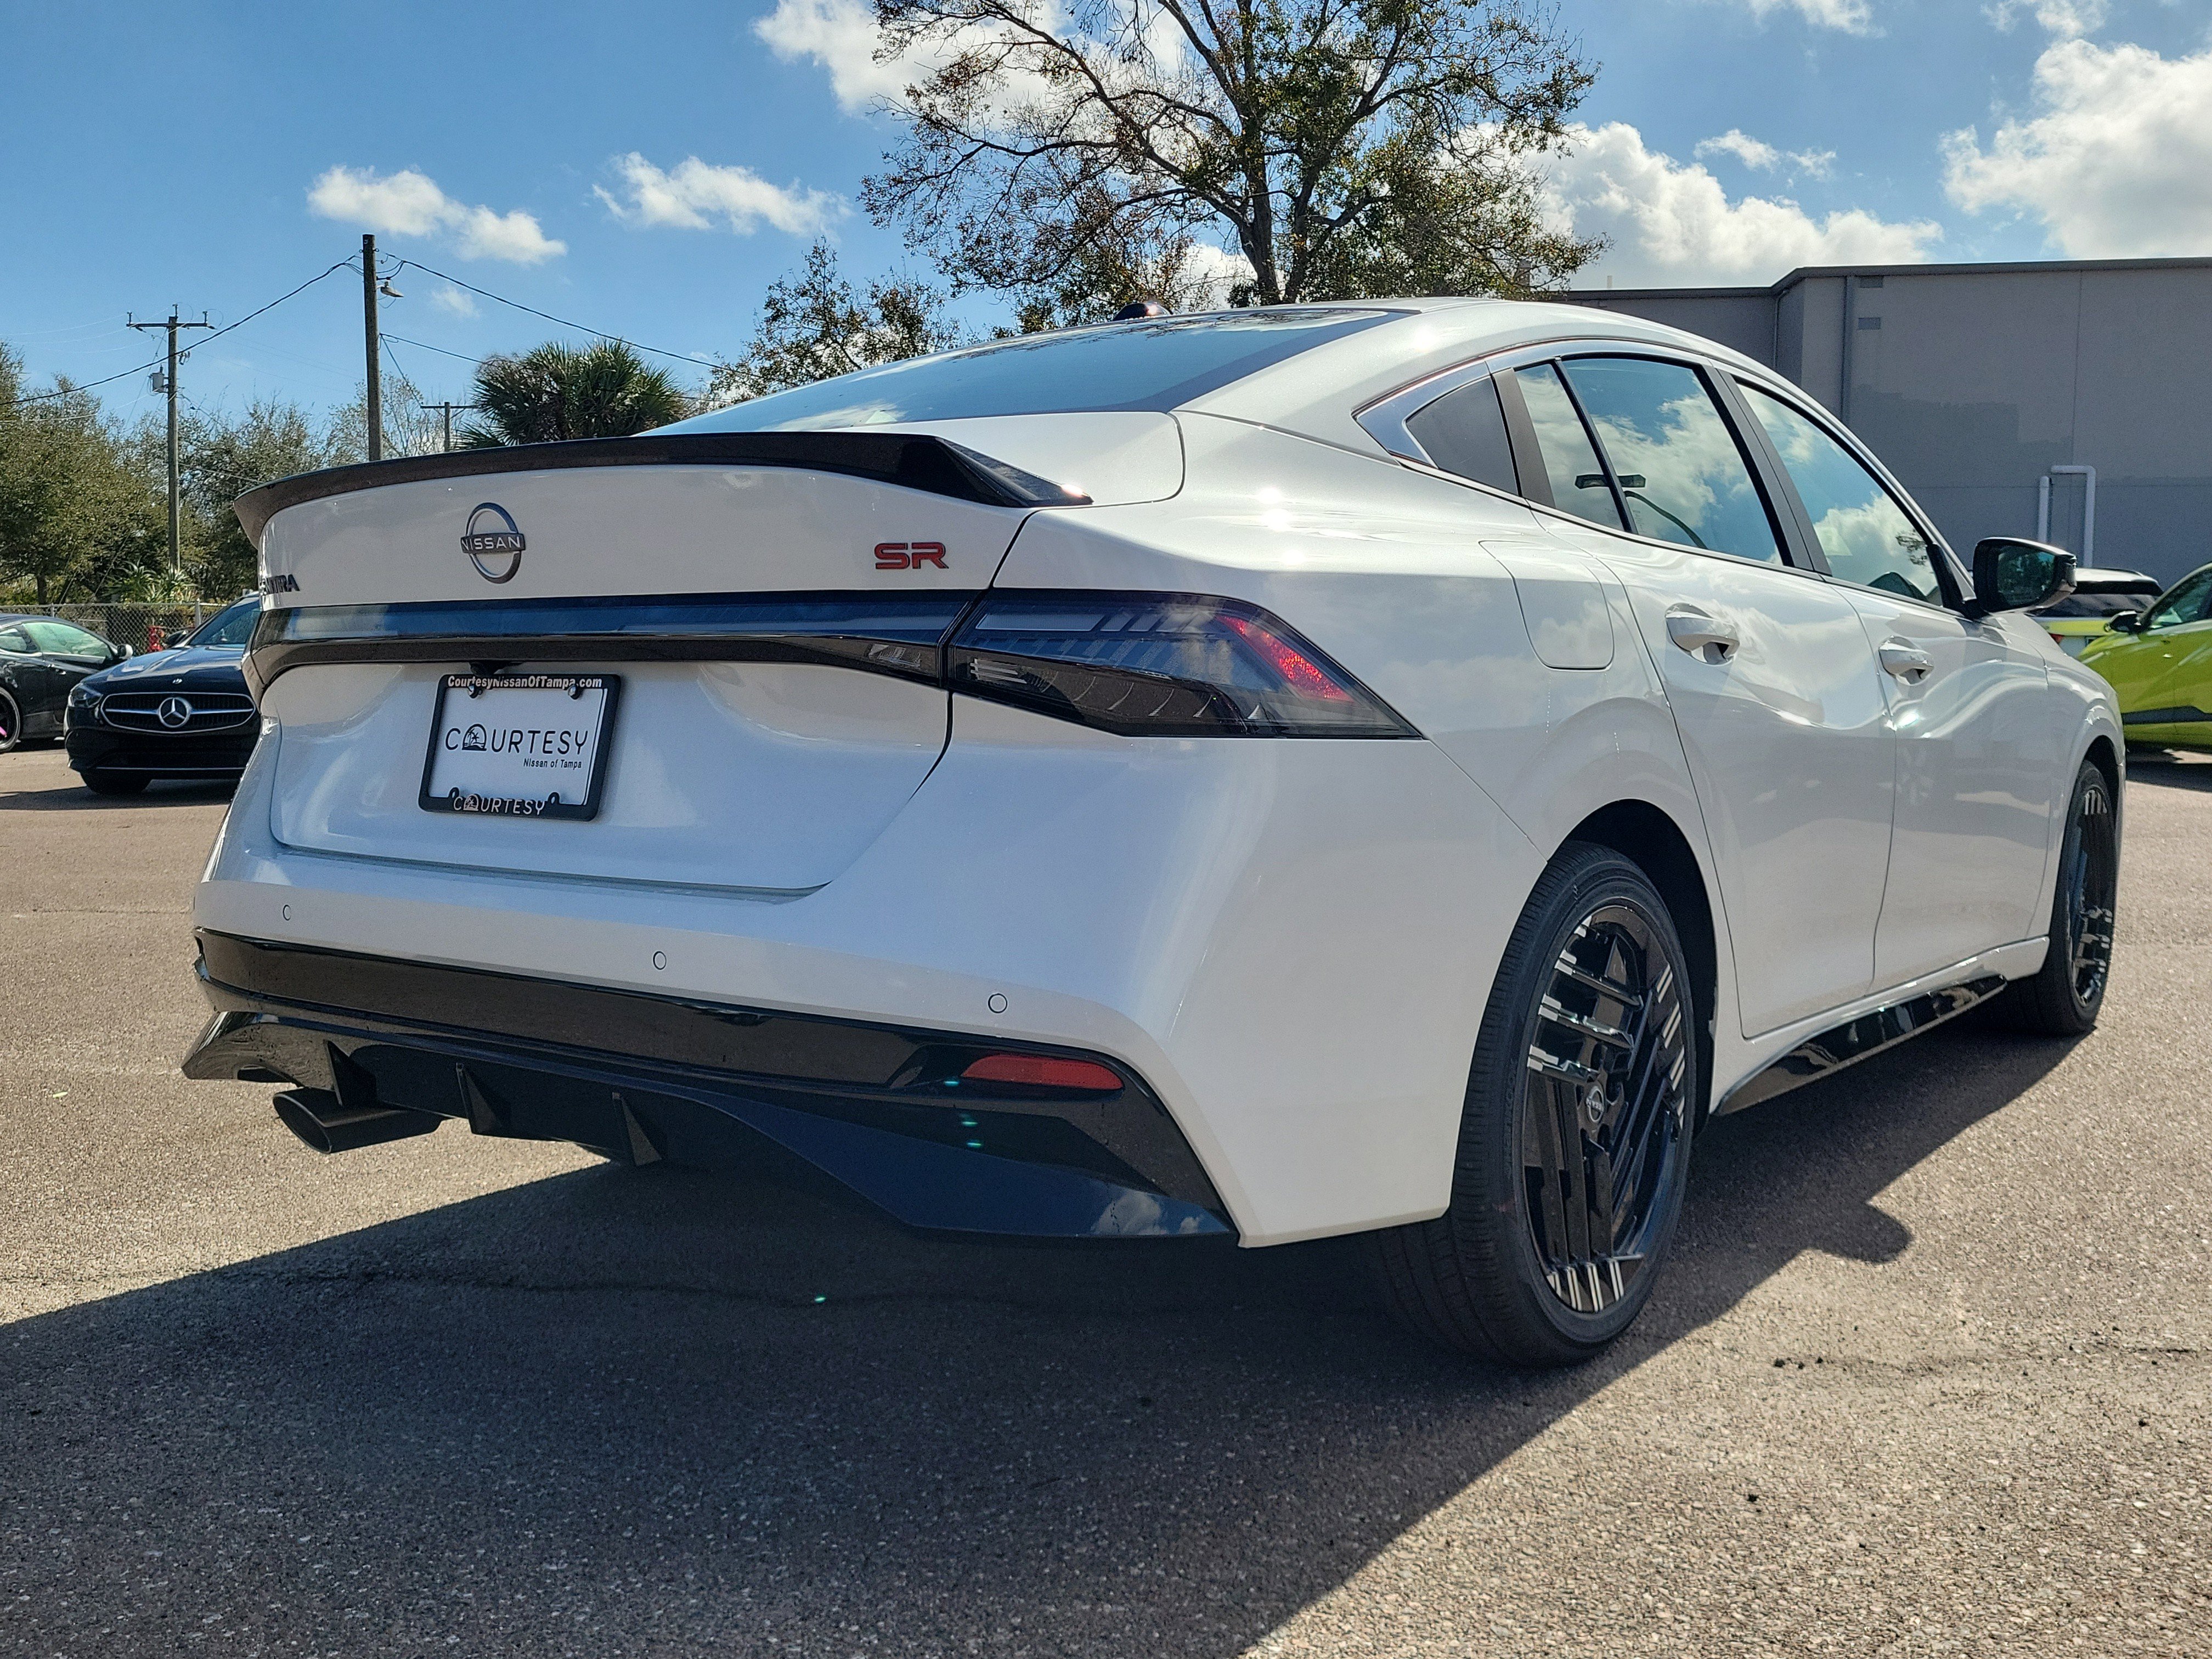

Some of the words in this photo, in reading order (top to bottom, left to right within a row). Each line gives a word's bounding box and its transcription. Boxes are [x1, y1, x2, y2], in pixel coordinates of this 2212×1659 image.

[461, 536, 521, 551] NISSAN
[874, 542, 949, 569] SR
[448, 675, 602, 689] CourtesyNissanOfTampa.com
[445, 724, 588, 754] COURTESY
[523, 758, 548, 768] Nissan
[550, 759, 558, 768] of
[561, 759, 582, 770] Tampa
[453, 794, 545, 815] COURTESY
